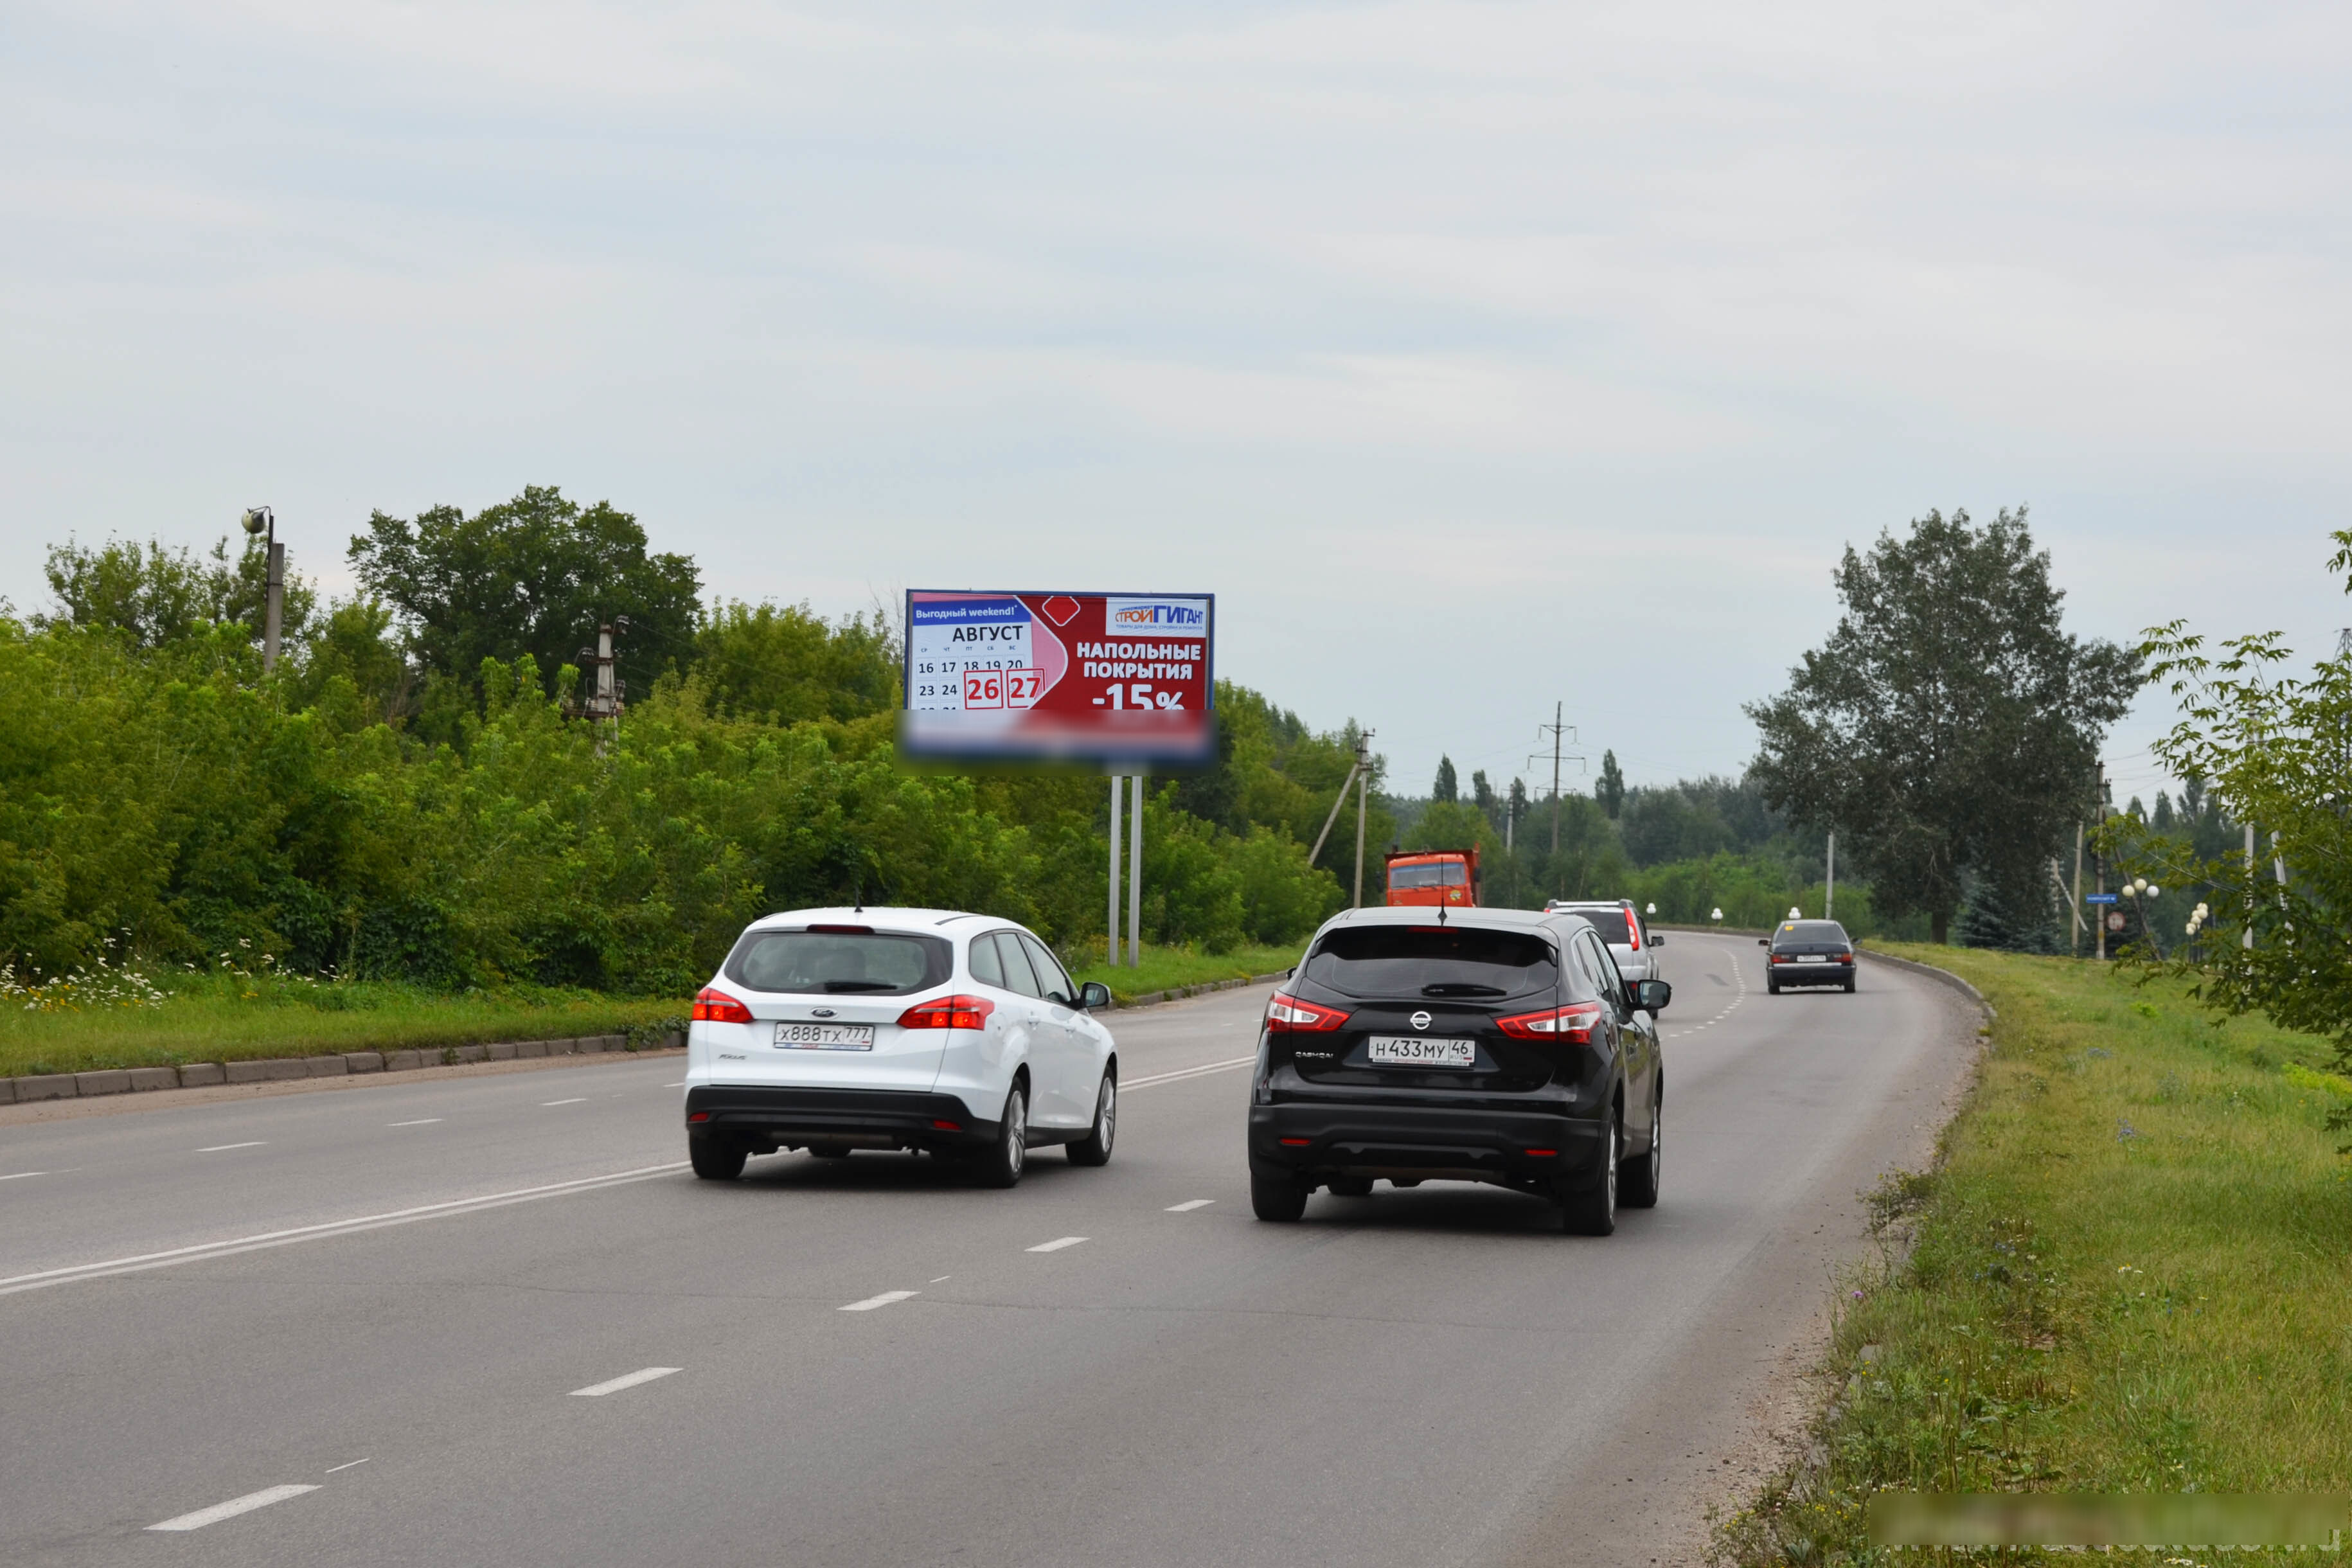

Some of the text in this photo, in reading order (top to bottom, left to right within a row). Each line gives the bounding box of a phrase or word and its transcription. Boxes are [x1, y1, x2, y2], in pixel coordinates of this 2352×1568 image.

[916, 608, 967, 619] Выгодный
[952, 625, 1023, 642] АВГУСТ
[1076, 642, 1201, 661] НАПОЛЬНЫЕ
[919, 660, 1022, 673] 16 17 18 19 20
[1083, 661, 1192, 679] ПОКРЫТИЯ
[920, 677, 1040, 700] 23 24 26 27
[1092, 684, 1185, 709] -15%
[846, 1027, 869, 1039] 777
[1452, 1041, 1468, 1055] 46
